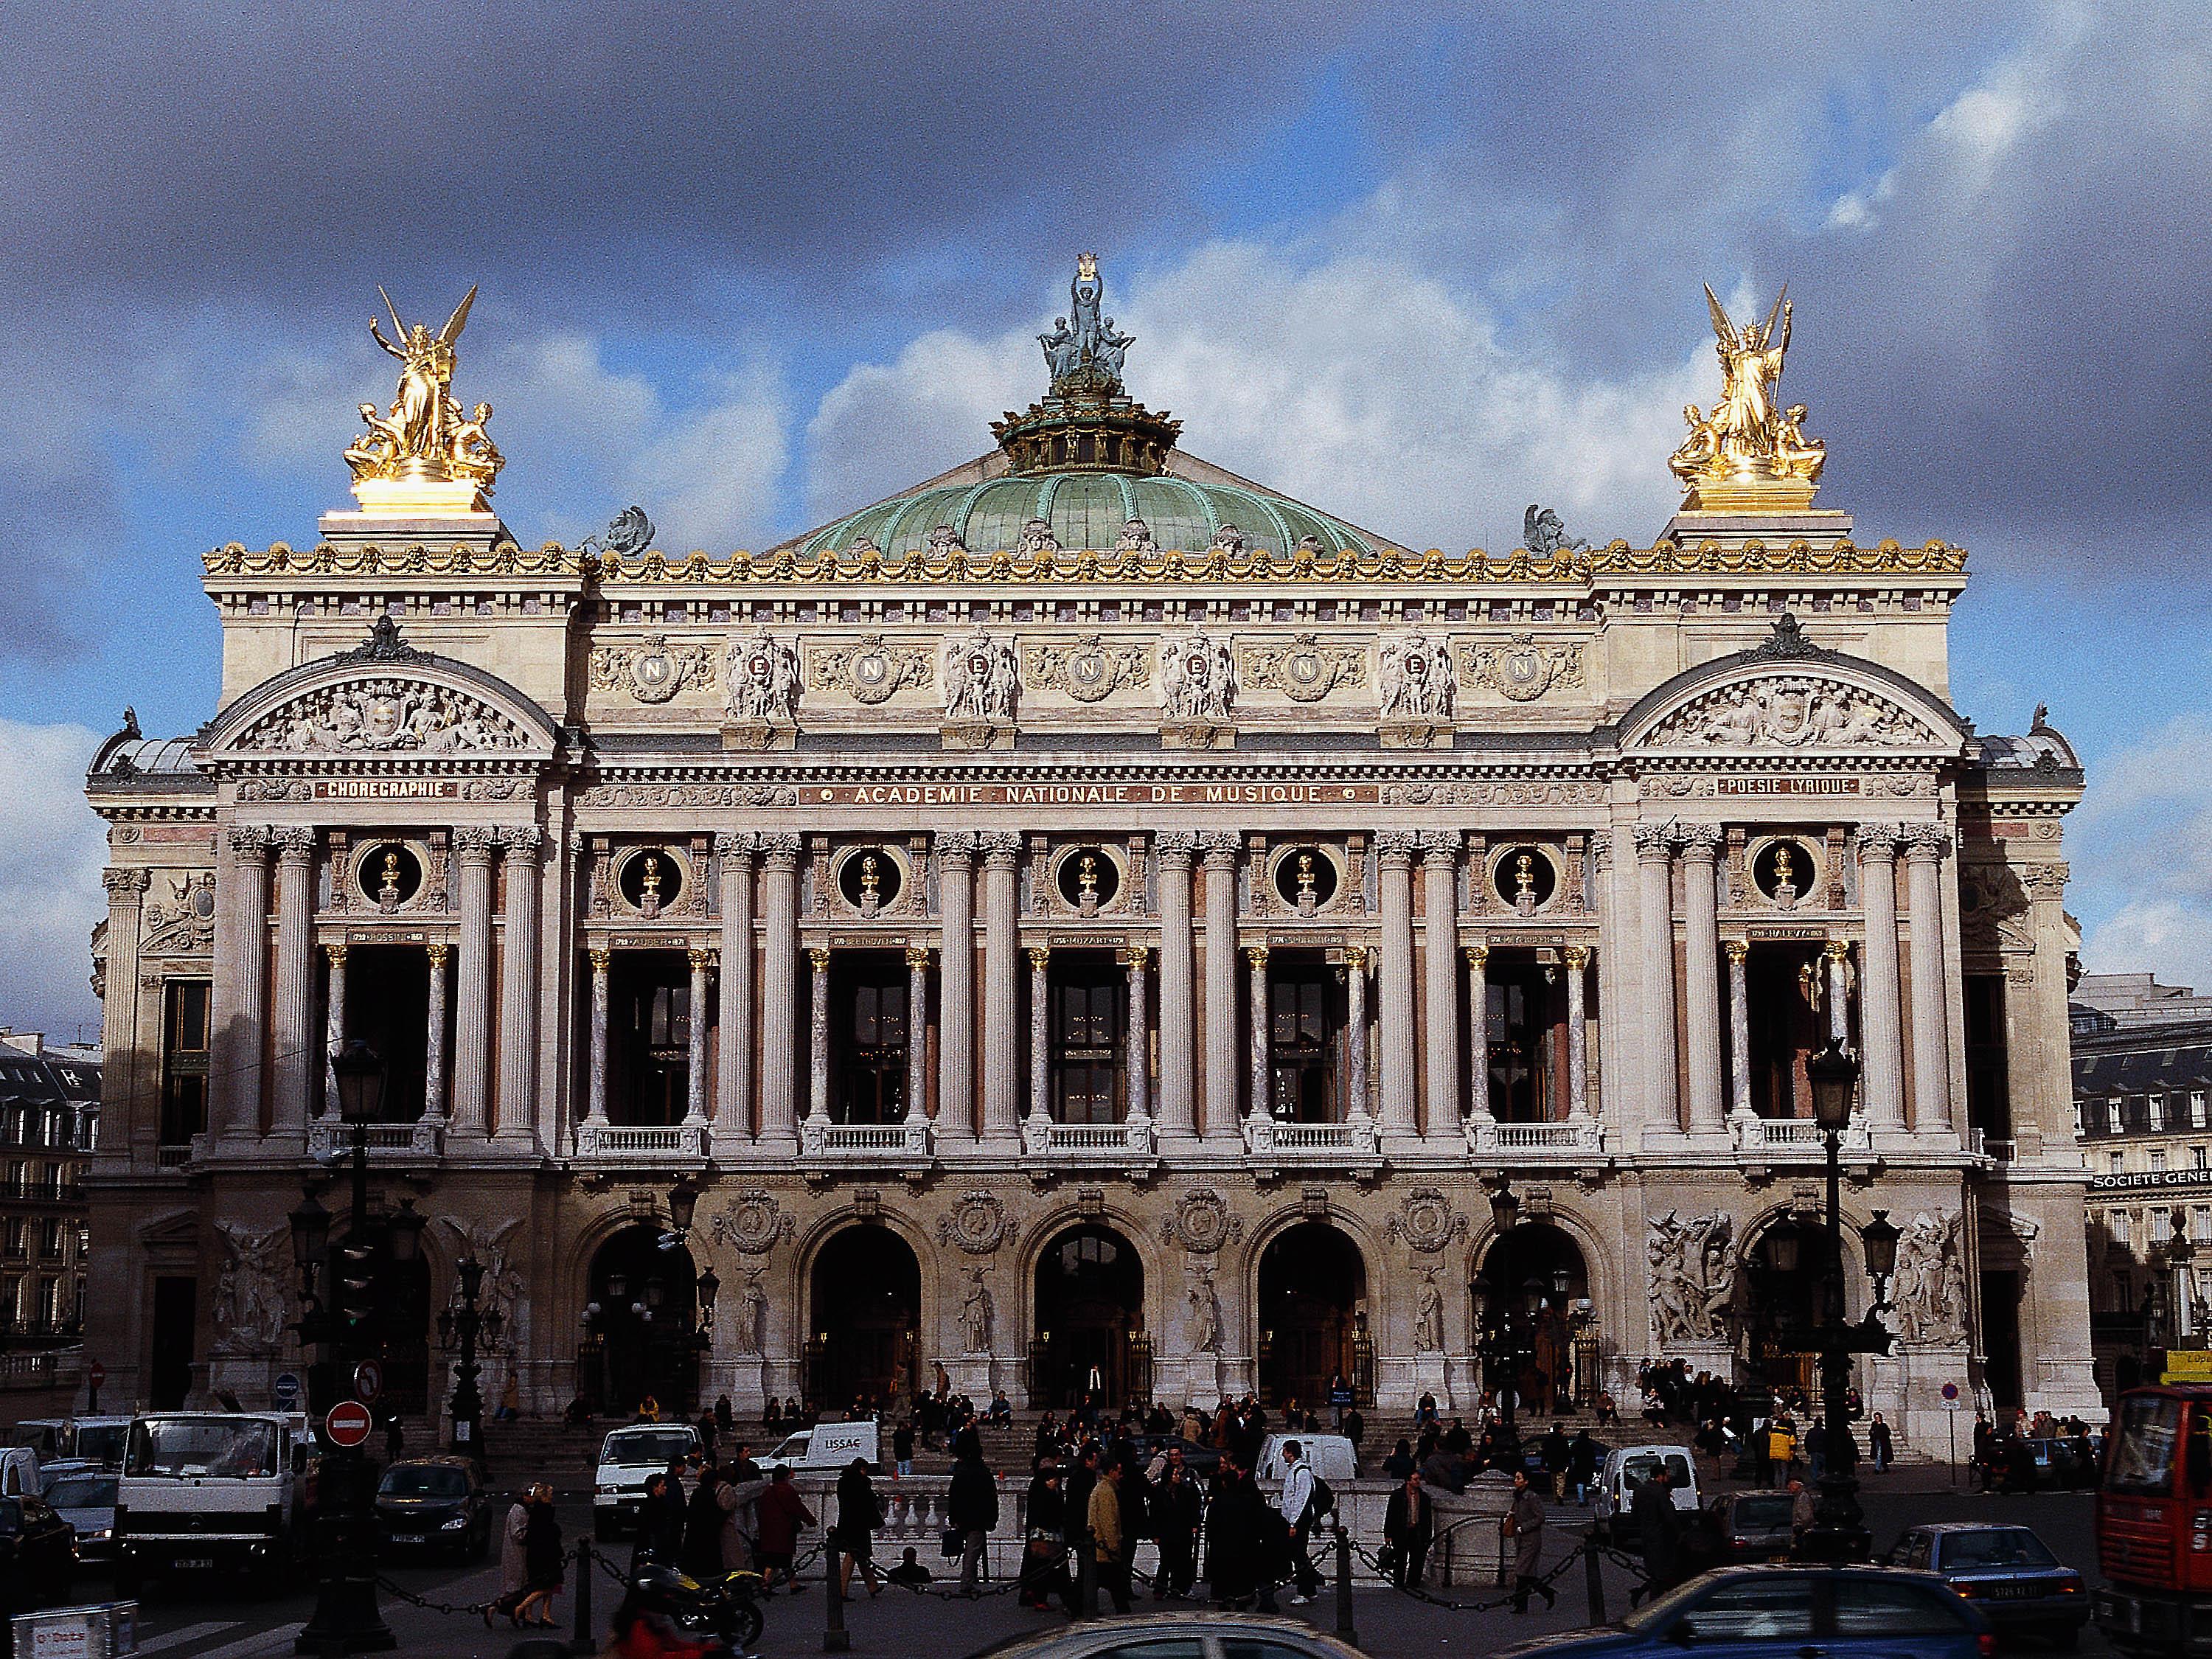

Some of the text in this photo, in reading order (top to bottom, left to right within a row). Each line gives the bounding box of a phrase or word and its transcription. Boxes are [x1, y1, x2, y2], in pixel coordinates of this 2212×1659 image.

[645, 662, 661, 678] N
[754, 659, 765, 674] E
[864, 661, 879, 677] N
[973, 658, 984, 672] E
[1081, 660, 1096, 676] N
[1192, 659, 1203, 673] E
[1298, 661, 1312, 676] N
[1410, 658, 1421, 672] E
[1515, 660, 1530, 676] N
[327, 782, 444, 797] CHOREGRAPHIE
[1728, 779, 1850, 793] POESIE LYRIQUE
[854, 786, 1321, 803] ACADEMIE NATIONALE DE MUSIQUE
[2165, 1171, 2212, 1183] GENE
